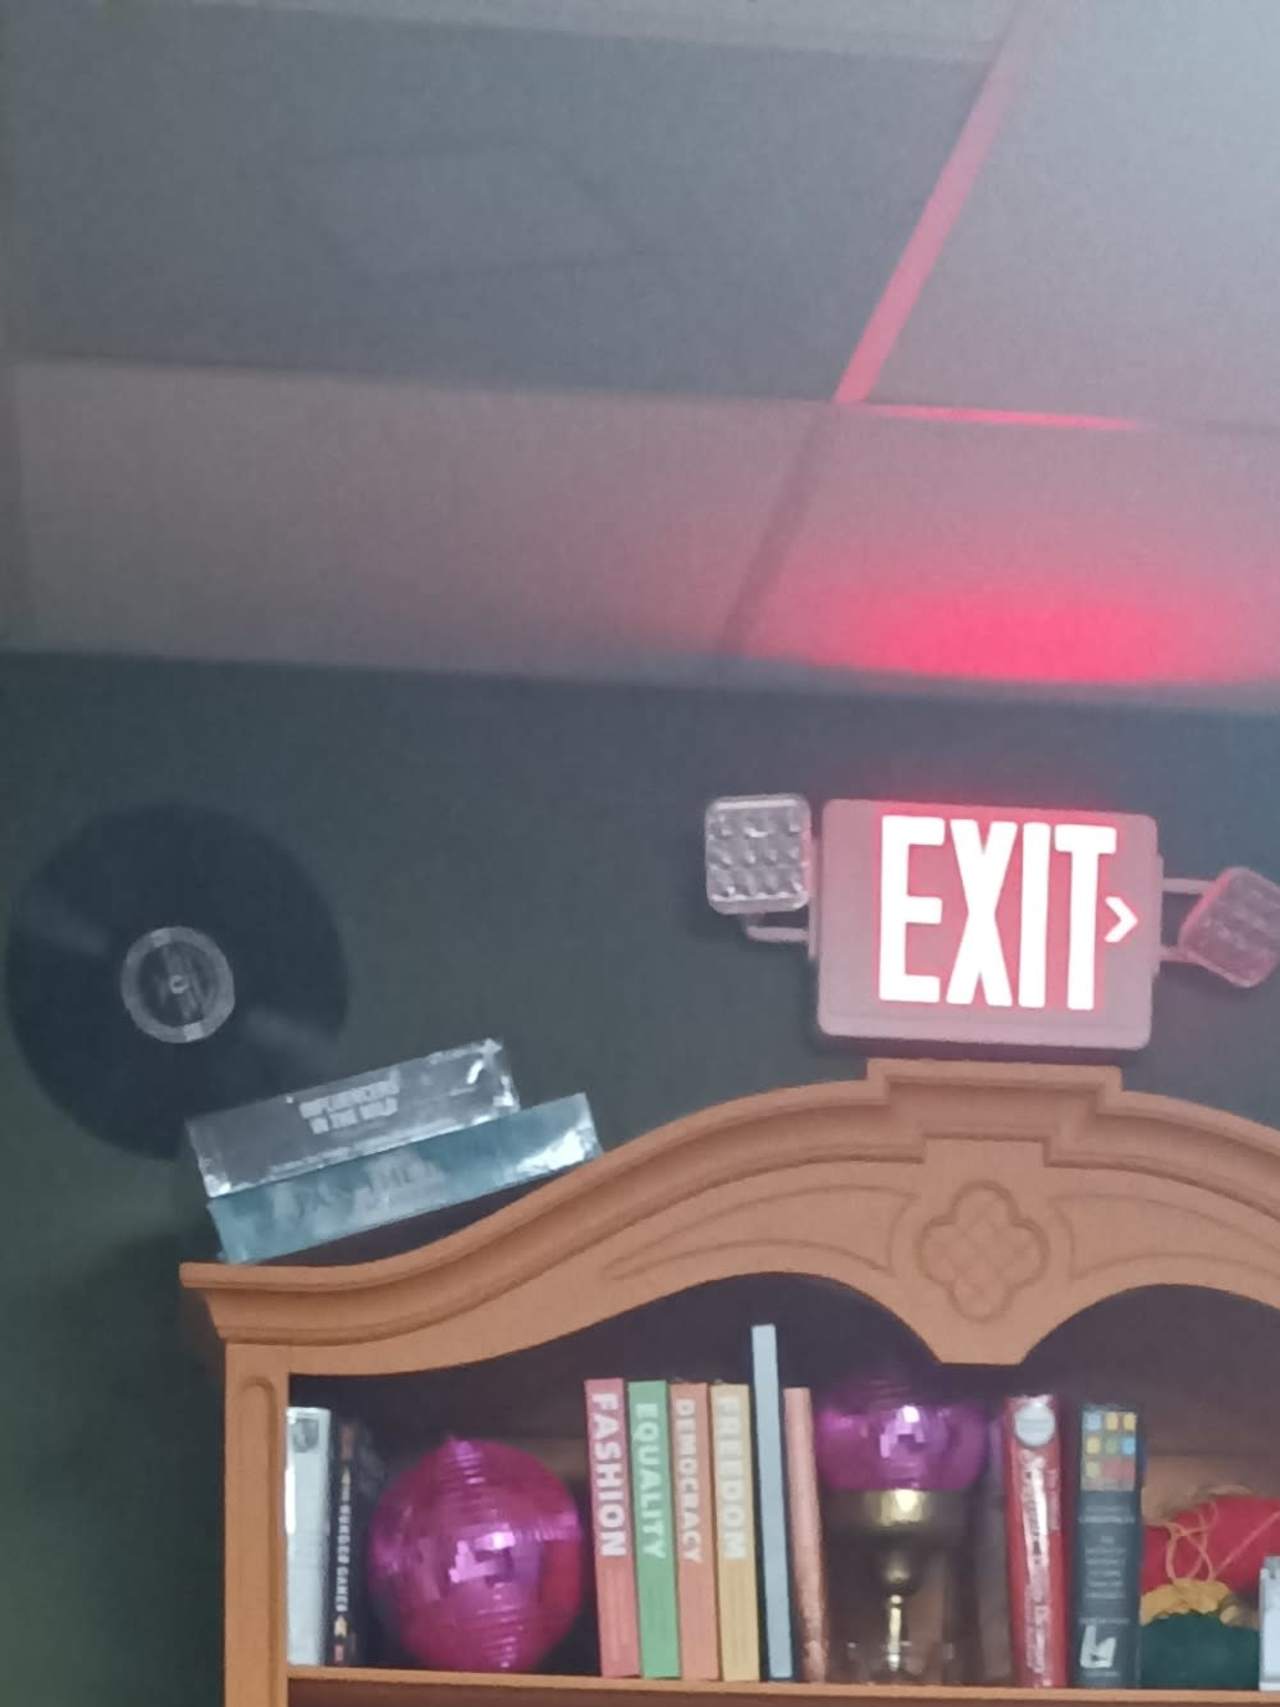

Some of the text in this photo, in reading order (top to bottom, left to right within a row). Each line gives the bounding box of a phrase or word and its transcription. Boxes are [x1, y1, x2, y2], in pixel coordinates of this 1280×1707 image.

[877, 813, 1118, 1012] EXIT
[590, 1392, 628, 1557] FASHION
[632, 1402, 667, 1559] EQUALITY
[674, 1398, 704, 1563] DEMOCRACY
[719, 1395, 748, 1560] FREEDOM
